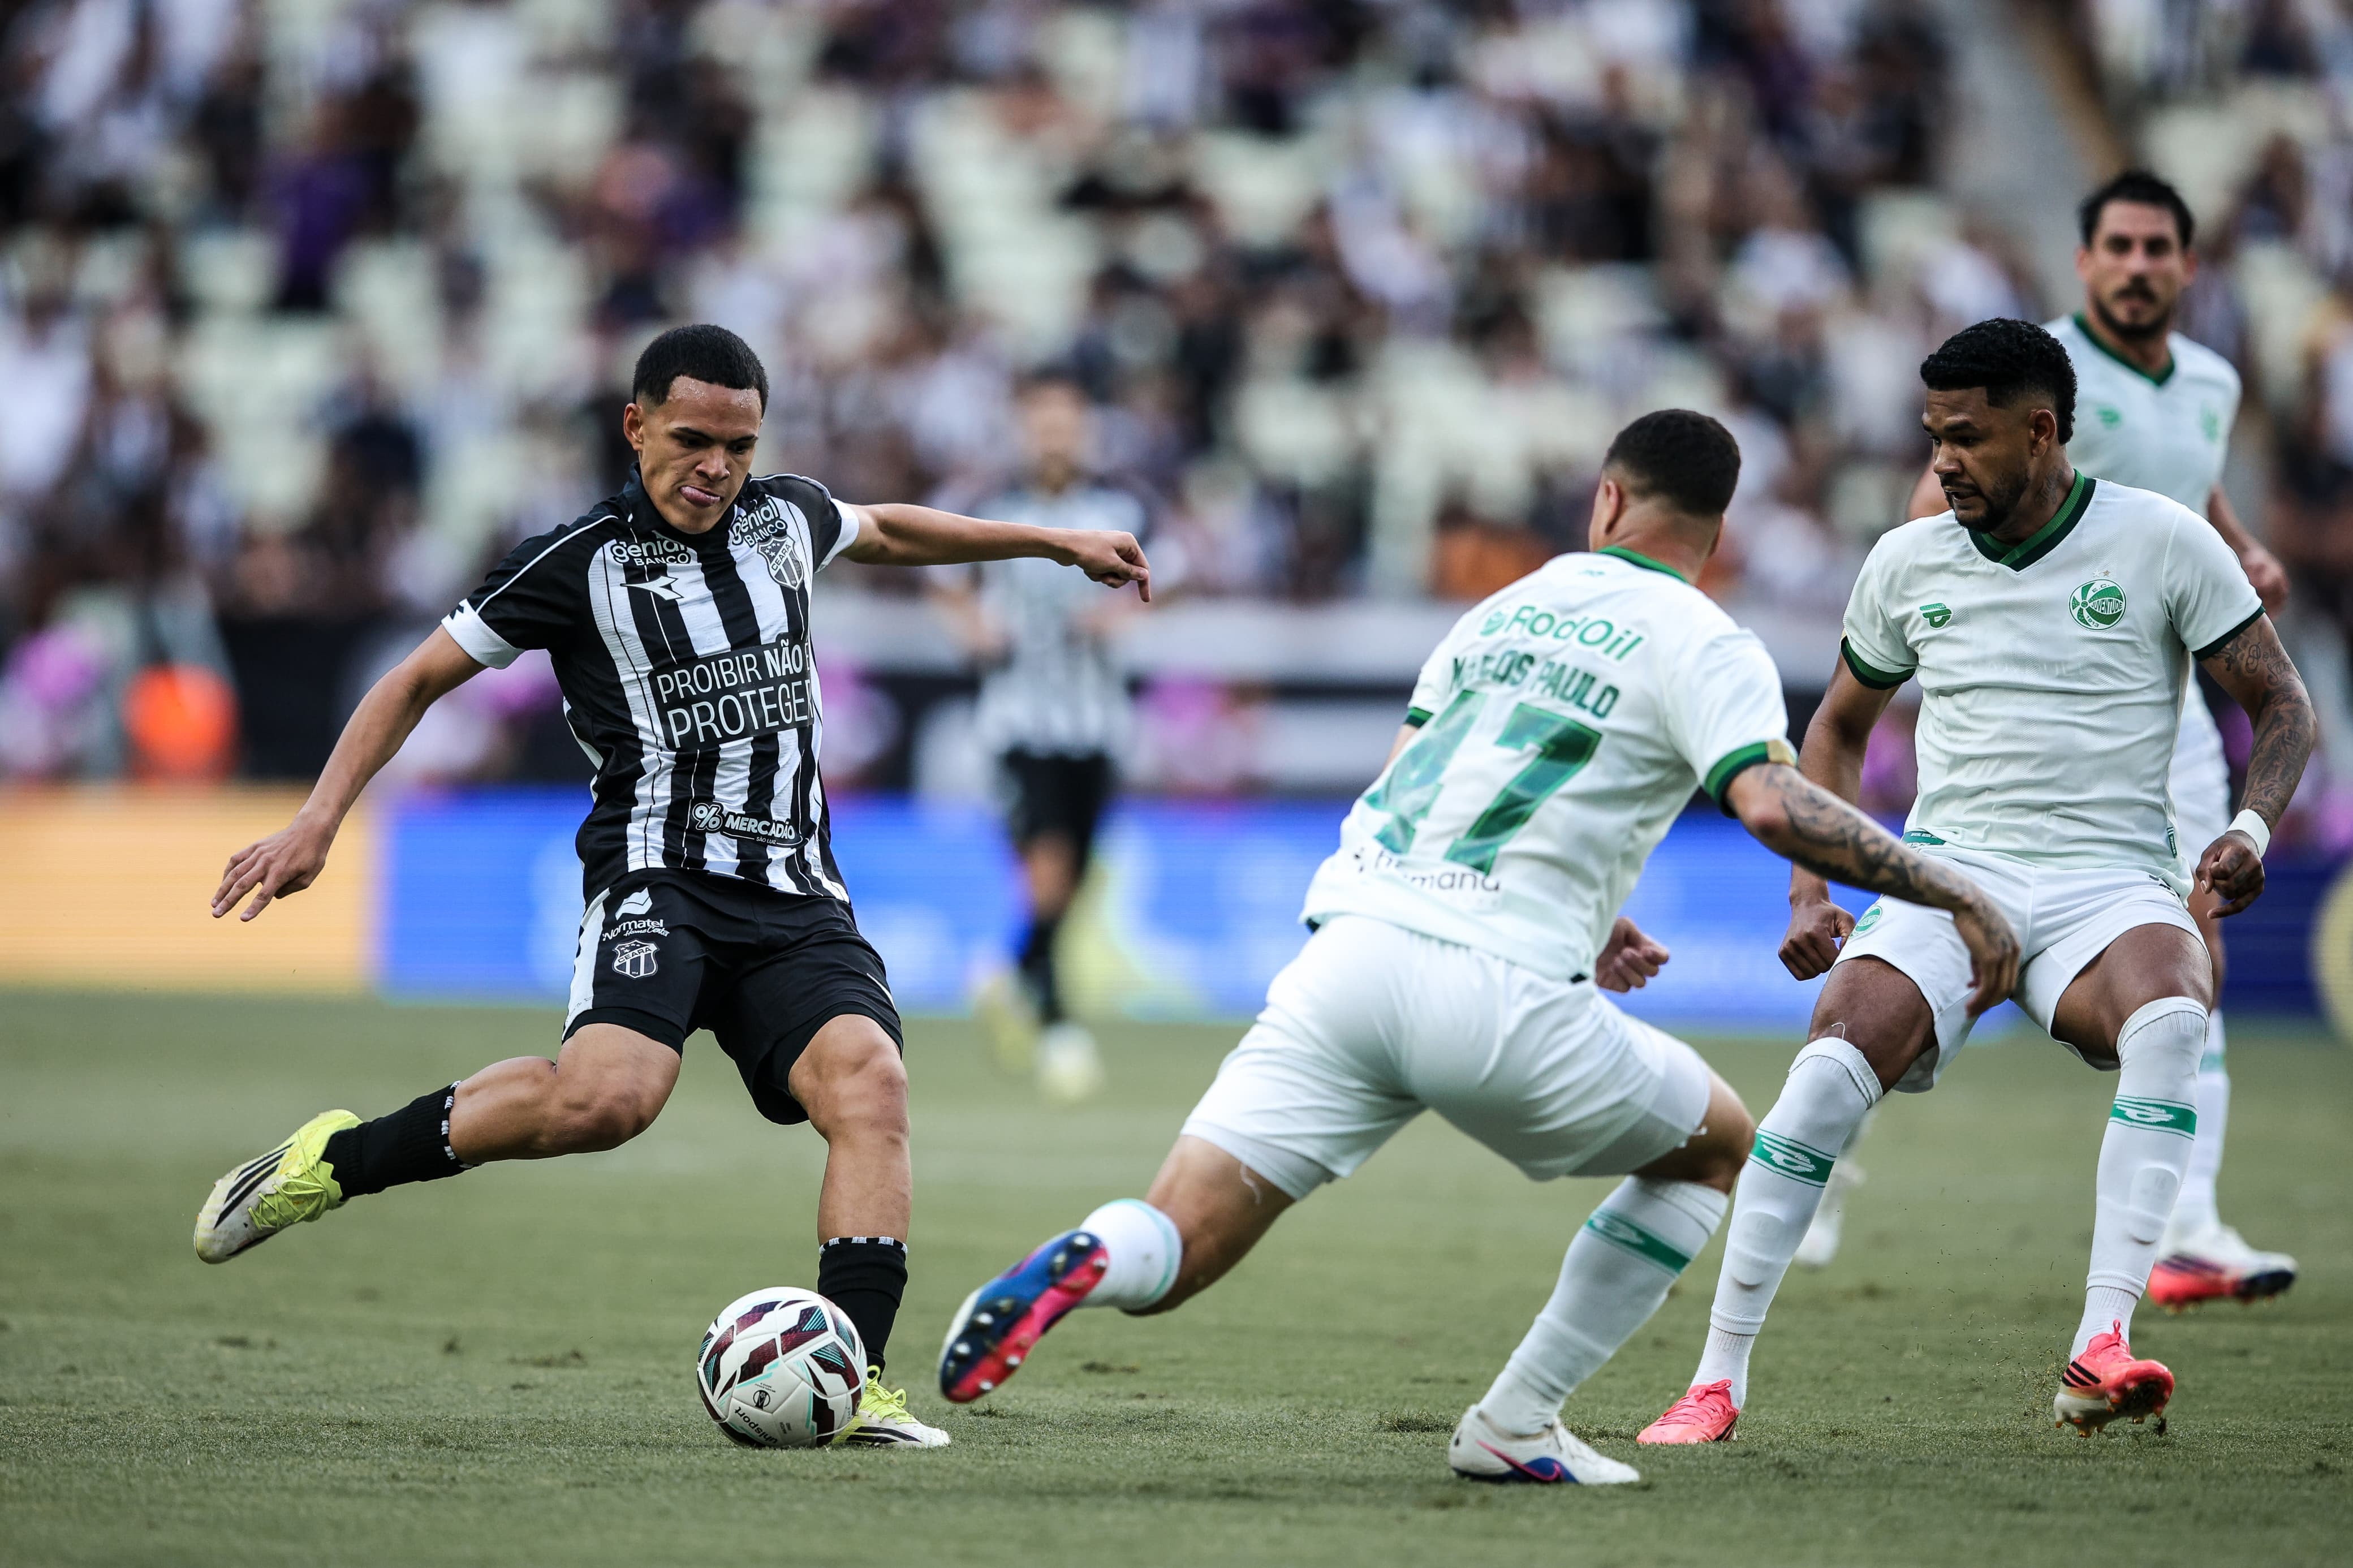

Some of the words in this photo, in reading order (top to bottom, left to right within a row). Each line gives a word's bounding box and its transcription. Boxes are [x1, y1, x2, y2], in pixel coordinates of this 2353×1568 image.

[732, 498, 779, 545] genial
[744, 520, 786, 546] BANCO
[634, 553, 689, 566] BANCO
[2091, 598, 2123, 614] JUVENTUDE
[656, 653, 762, 703] PROIBIR
[764, 638, 803, 679] NÃO
[1530, 661, 1620, 720] PAULO
[667, 679, 815, 749] PROTEGER
[1364, 688, 1602, 877] 47
[725, 814, 796, 839] MERCADÃO
[602, 919, 664, 941] Normatel
[618, 946, 652, 963] CEARÁ
[734, 1406, 778, 1444] uhlsport
